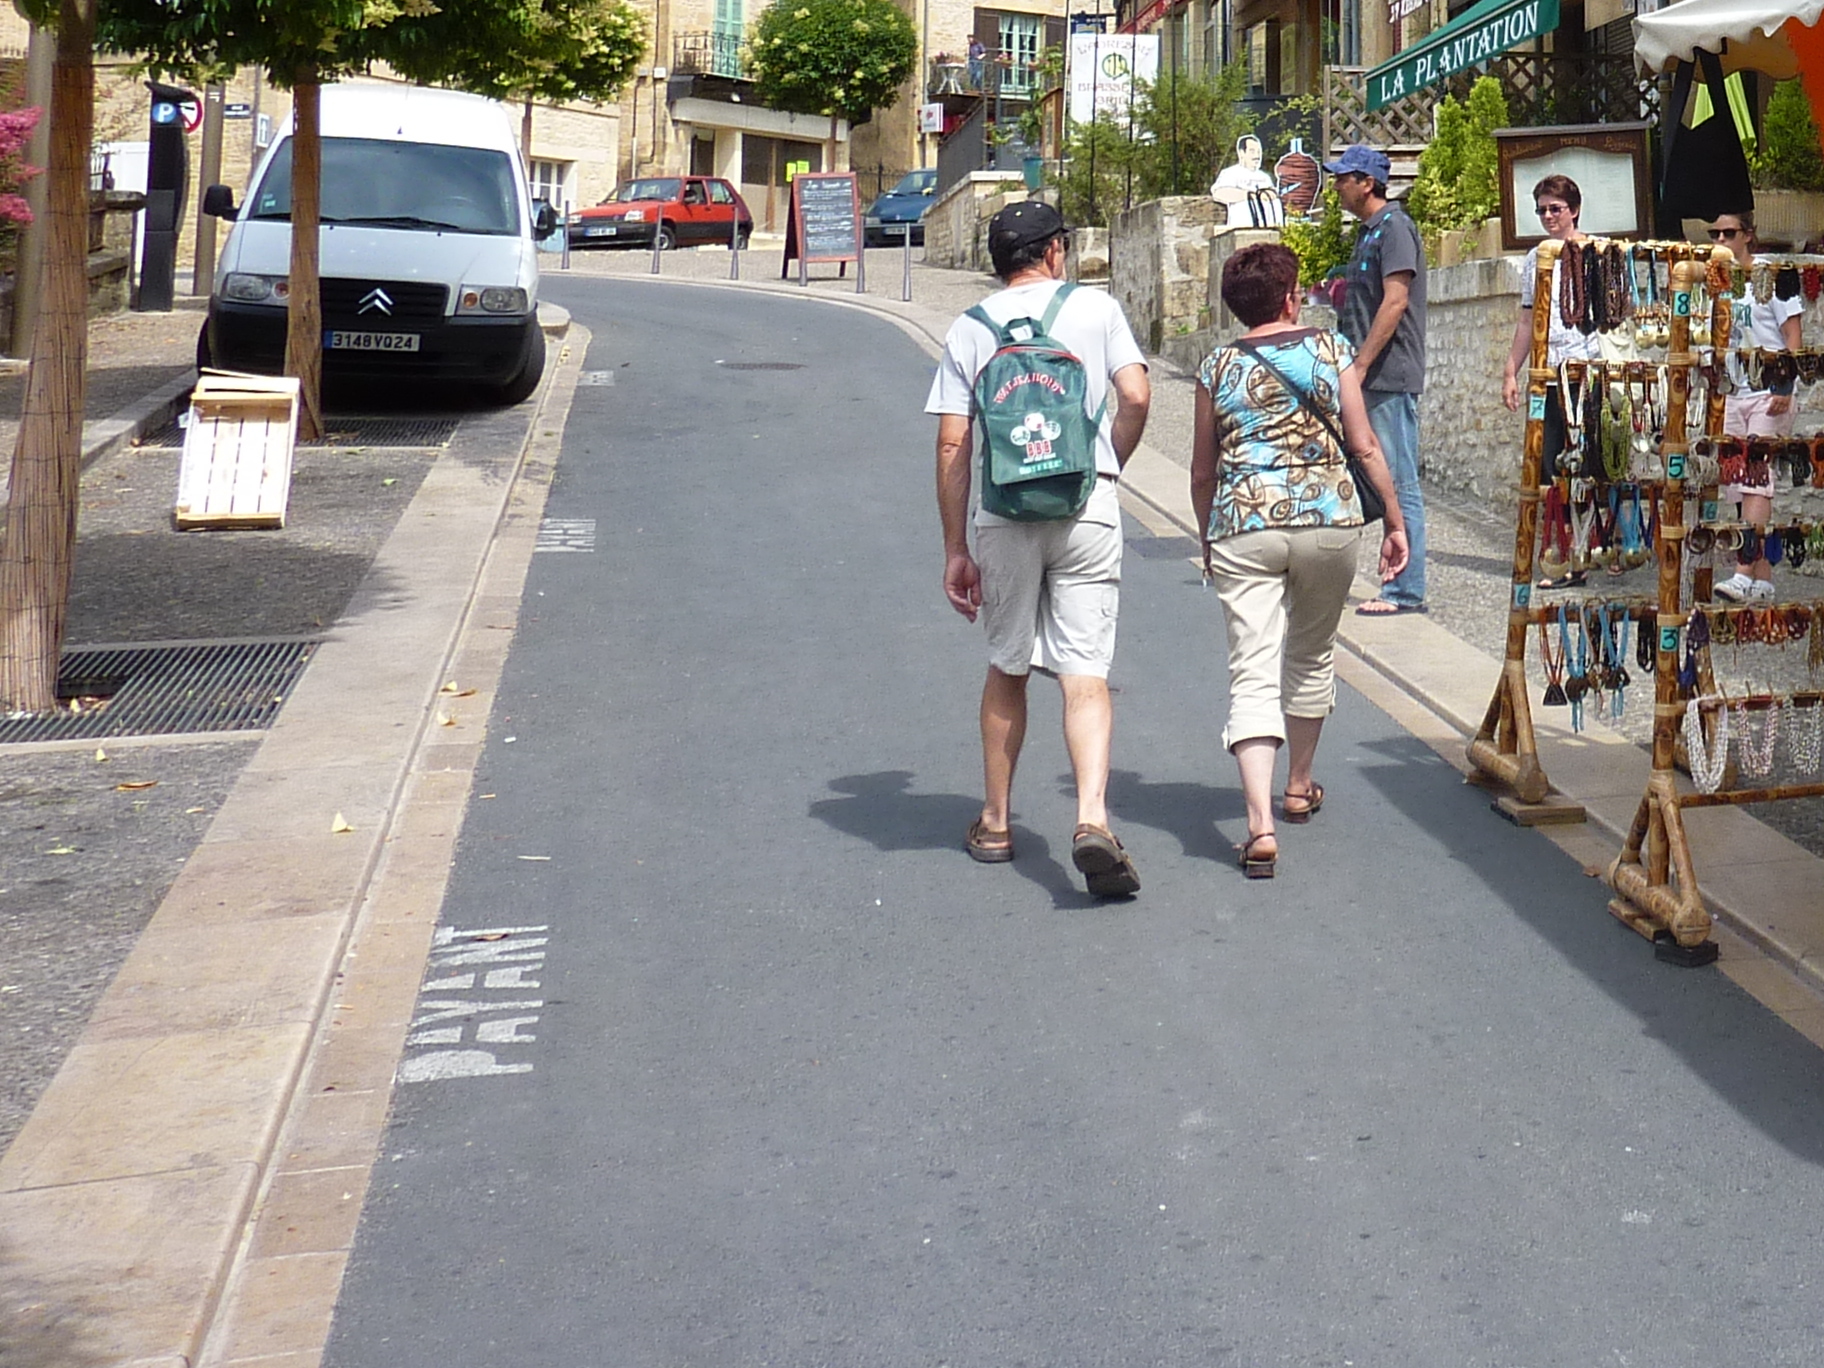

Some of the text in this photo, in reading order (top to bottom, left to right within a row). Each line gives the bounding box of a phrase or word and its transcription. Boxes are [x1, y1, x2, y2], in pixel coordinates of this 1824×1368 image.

[1381, 1, 1540, 102] LA PLANTATION
[1678, 293, 1690, 315] 8
[1662, 628, 1677, 650] 3
